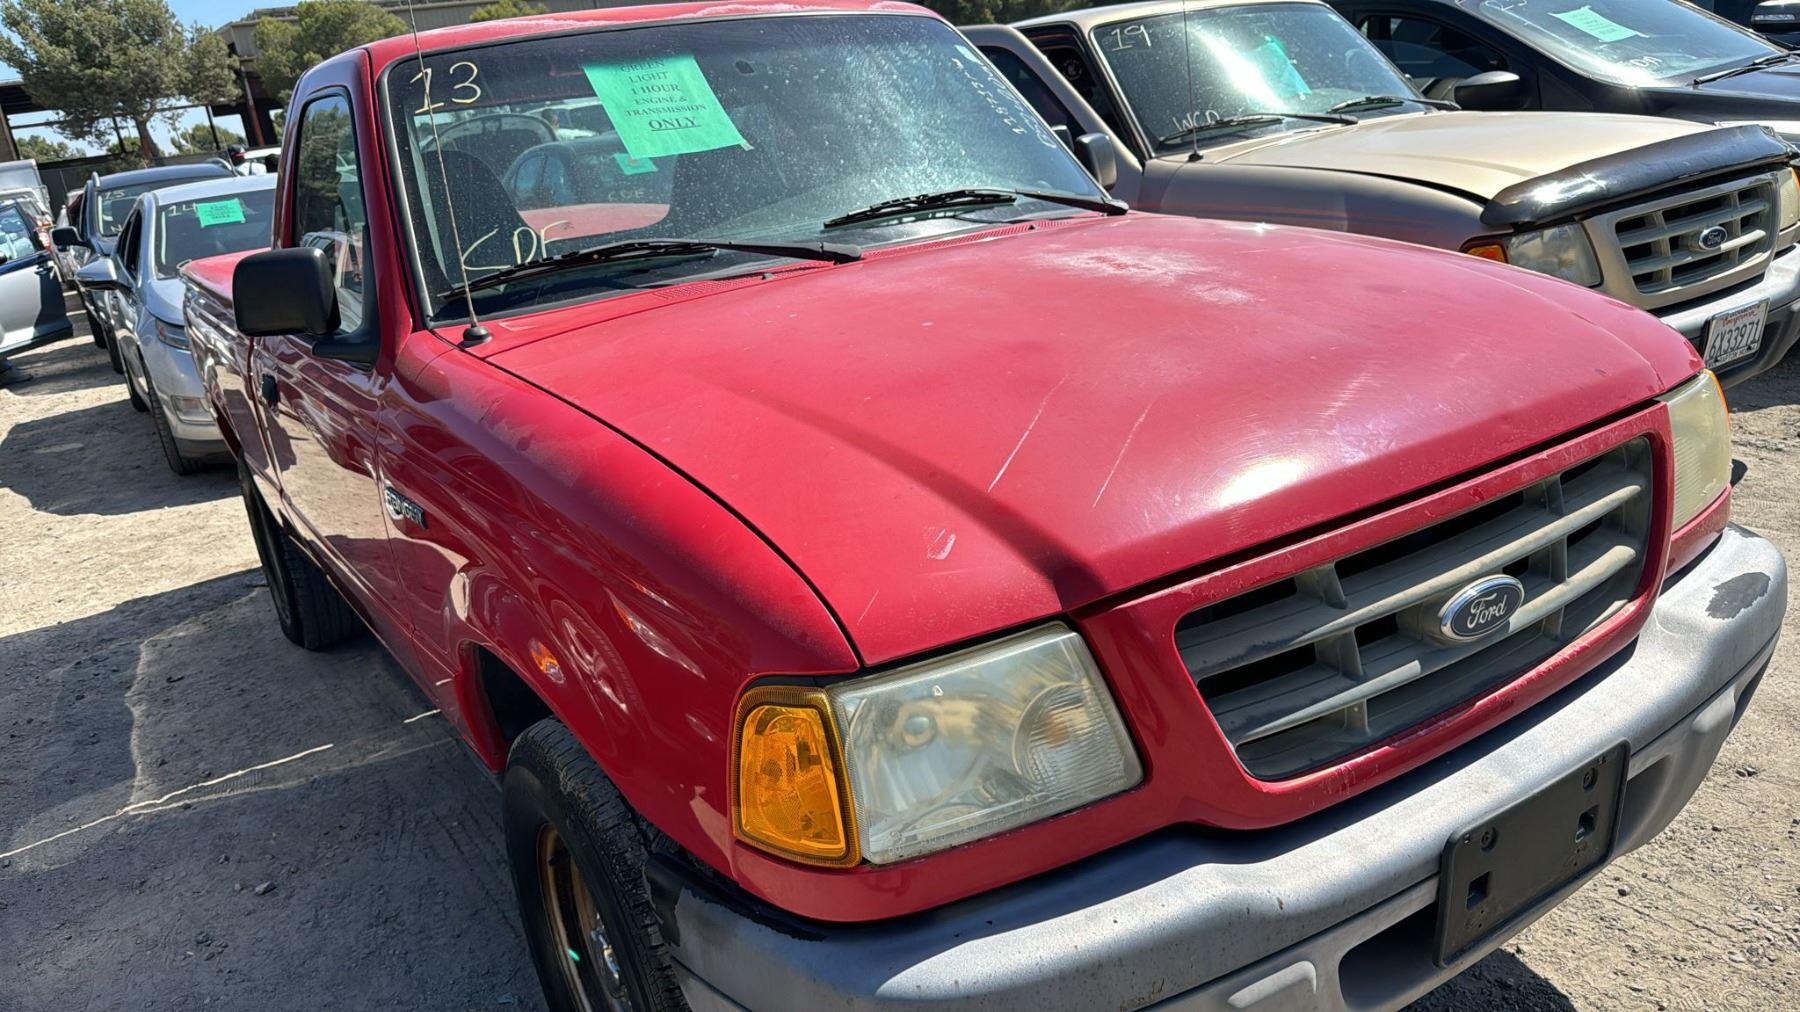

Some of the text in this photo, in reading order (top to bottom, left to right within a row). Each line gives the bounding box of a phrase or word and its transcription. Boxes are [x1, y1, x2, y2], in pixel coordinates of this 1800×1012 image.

[1111, 24, 1152, 51] 19
[620, 60, 665, 73] GREEN
[628, 71, 669, 84] LIGHT
[410, 61, 482, 114] 13
[631, 83, 681, 96] 1 HOUR
[634, 95, 688, 106] ENGINE &
[625, 103, 707, 118] TRANSMISSION
[648, 116, 699, 130] ONLY
[1708, 319, 1760, 360] 6X33971
[1466, 592, 1508, 629] Ford
